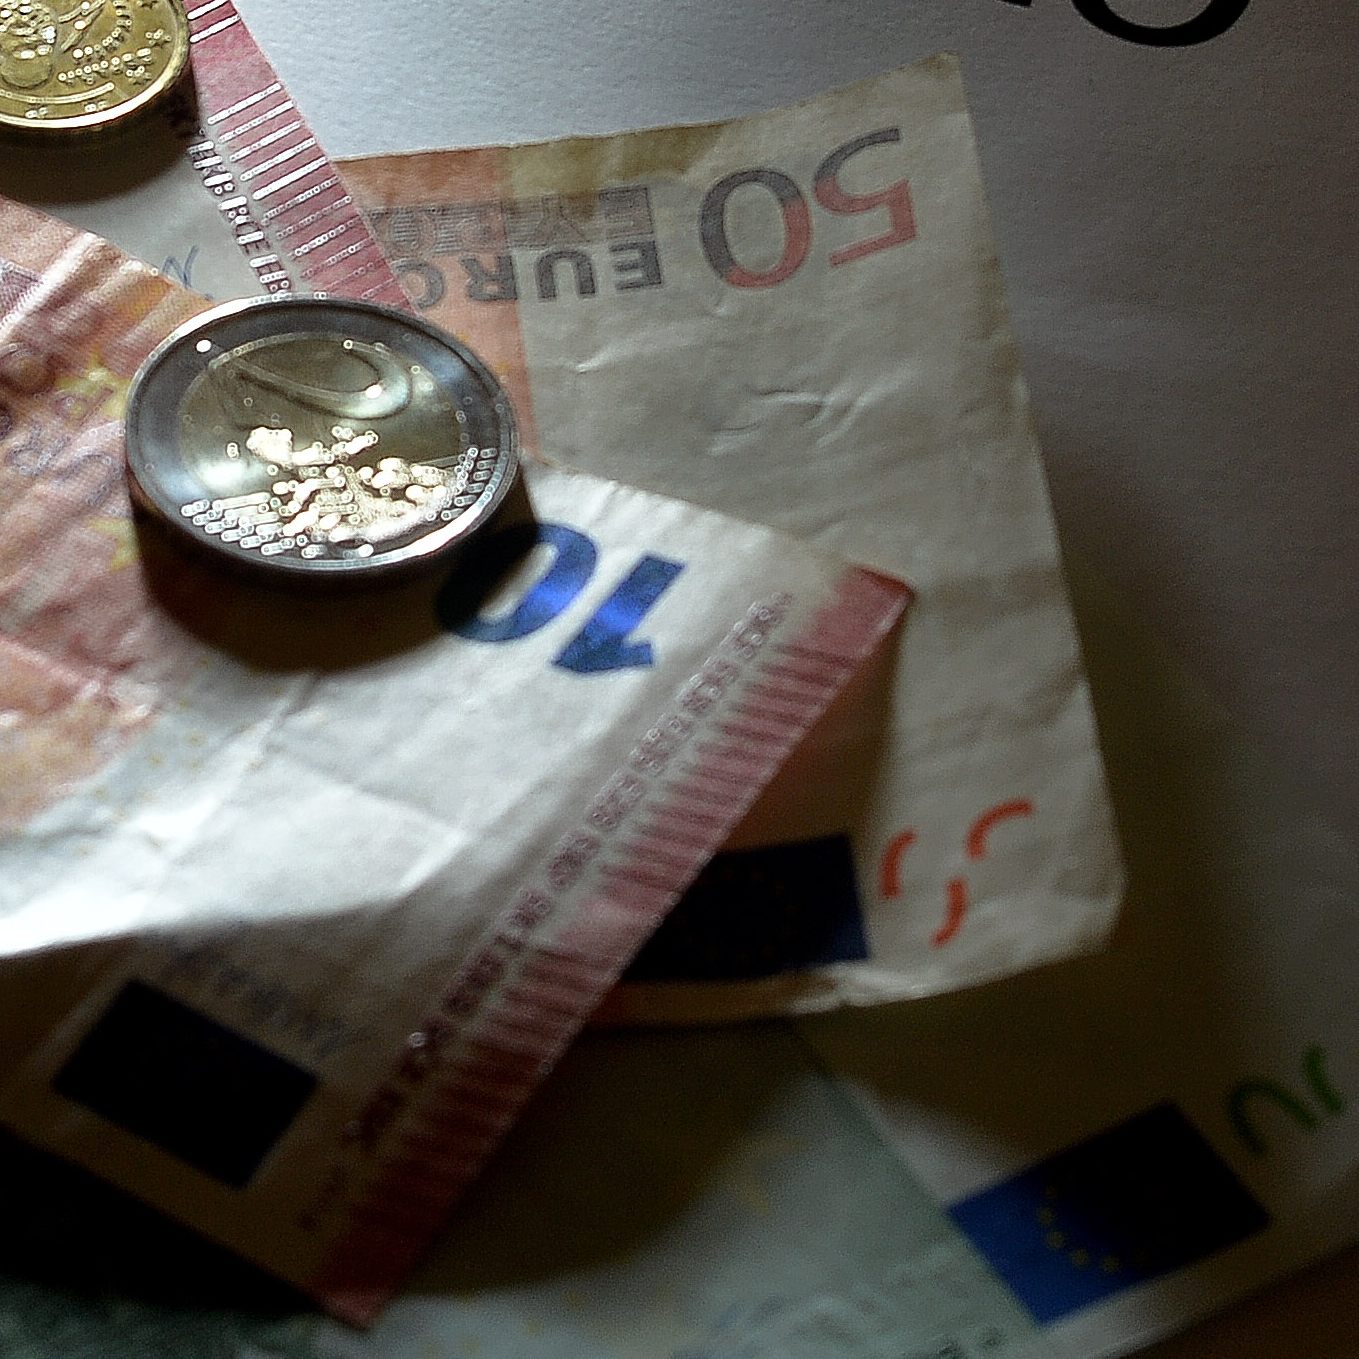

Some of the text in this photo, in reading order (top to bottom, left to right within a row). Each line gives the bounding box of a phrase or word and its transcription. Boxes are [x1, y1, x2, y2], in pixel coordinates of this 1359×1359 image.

[392, 125, 919, 310] 50 EURO
[437, 520, 686, 674] 10
